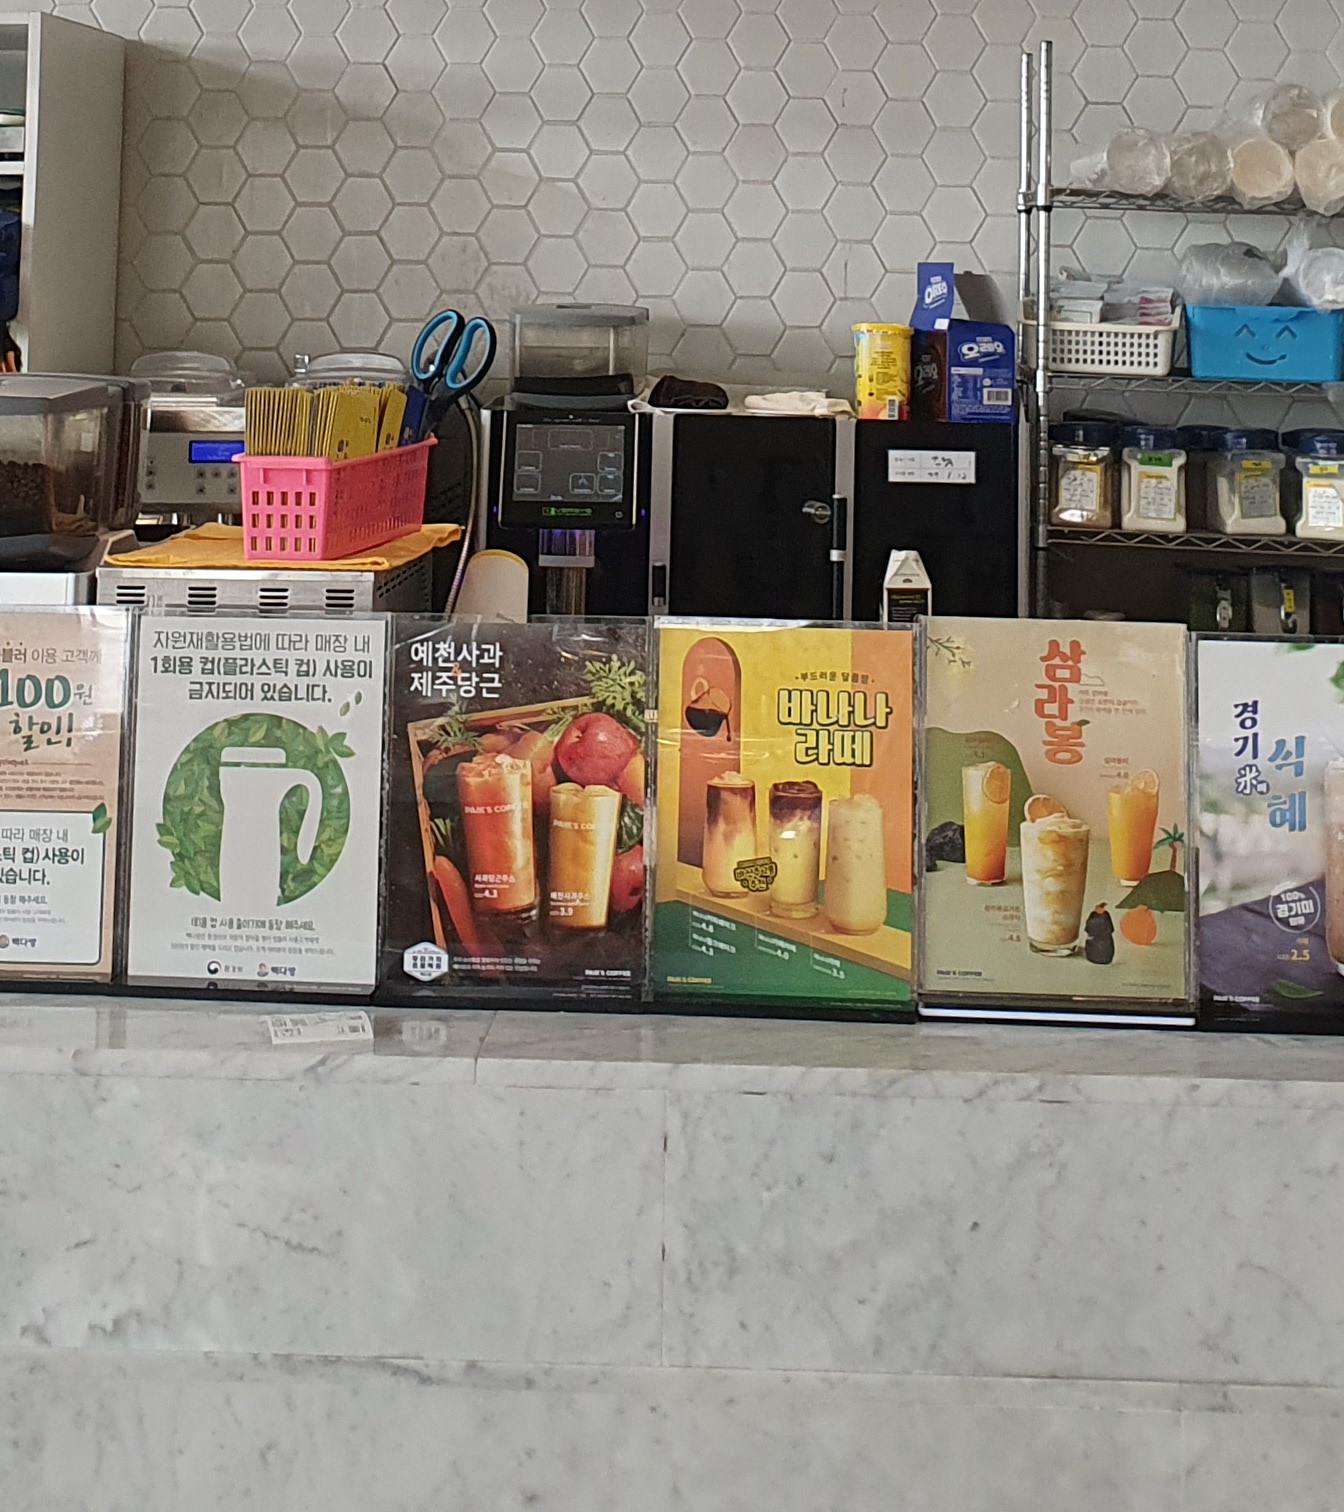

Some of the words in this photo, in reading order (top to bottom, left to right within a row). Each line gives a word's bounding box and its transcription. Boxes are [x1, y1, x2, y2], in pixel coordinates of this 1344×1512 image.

[153, 630, 270, 651] 자원재활용법에
[276, 632, 309, 652] 따라
[315, 633, 348, 653] 매장
[355, 633, 370, 653] 내
[410, 641, 503, 667] 예천사과
[150, 655, 193, 675] 1회용
[199, 656, 290, 678] 컵(플라스틱
[295, 657, 317, 678] 컵)
[323, 659, 373, 679] 사용이
[188, 681, 255, 701] 금지되어
[260, 681, 332, 703] 있습니다.
[410, 670, 503, 698] 제주당근
[777, 689, 893, 729] 바나나
[1034, 638, 1087, 765] 삼라봉
[9, 712, 73, 752] 할인!
[795, 728, 873, 767] 라떼
[1267, 735, 1307, 832] 식혜
[1291, 949, 1310, 961] 2.5
